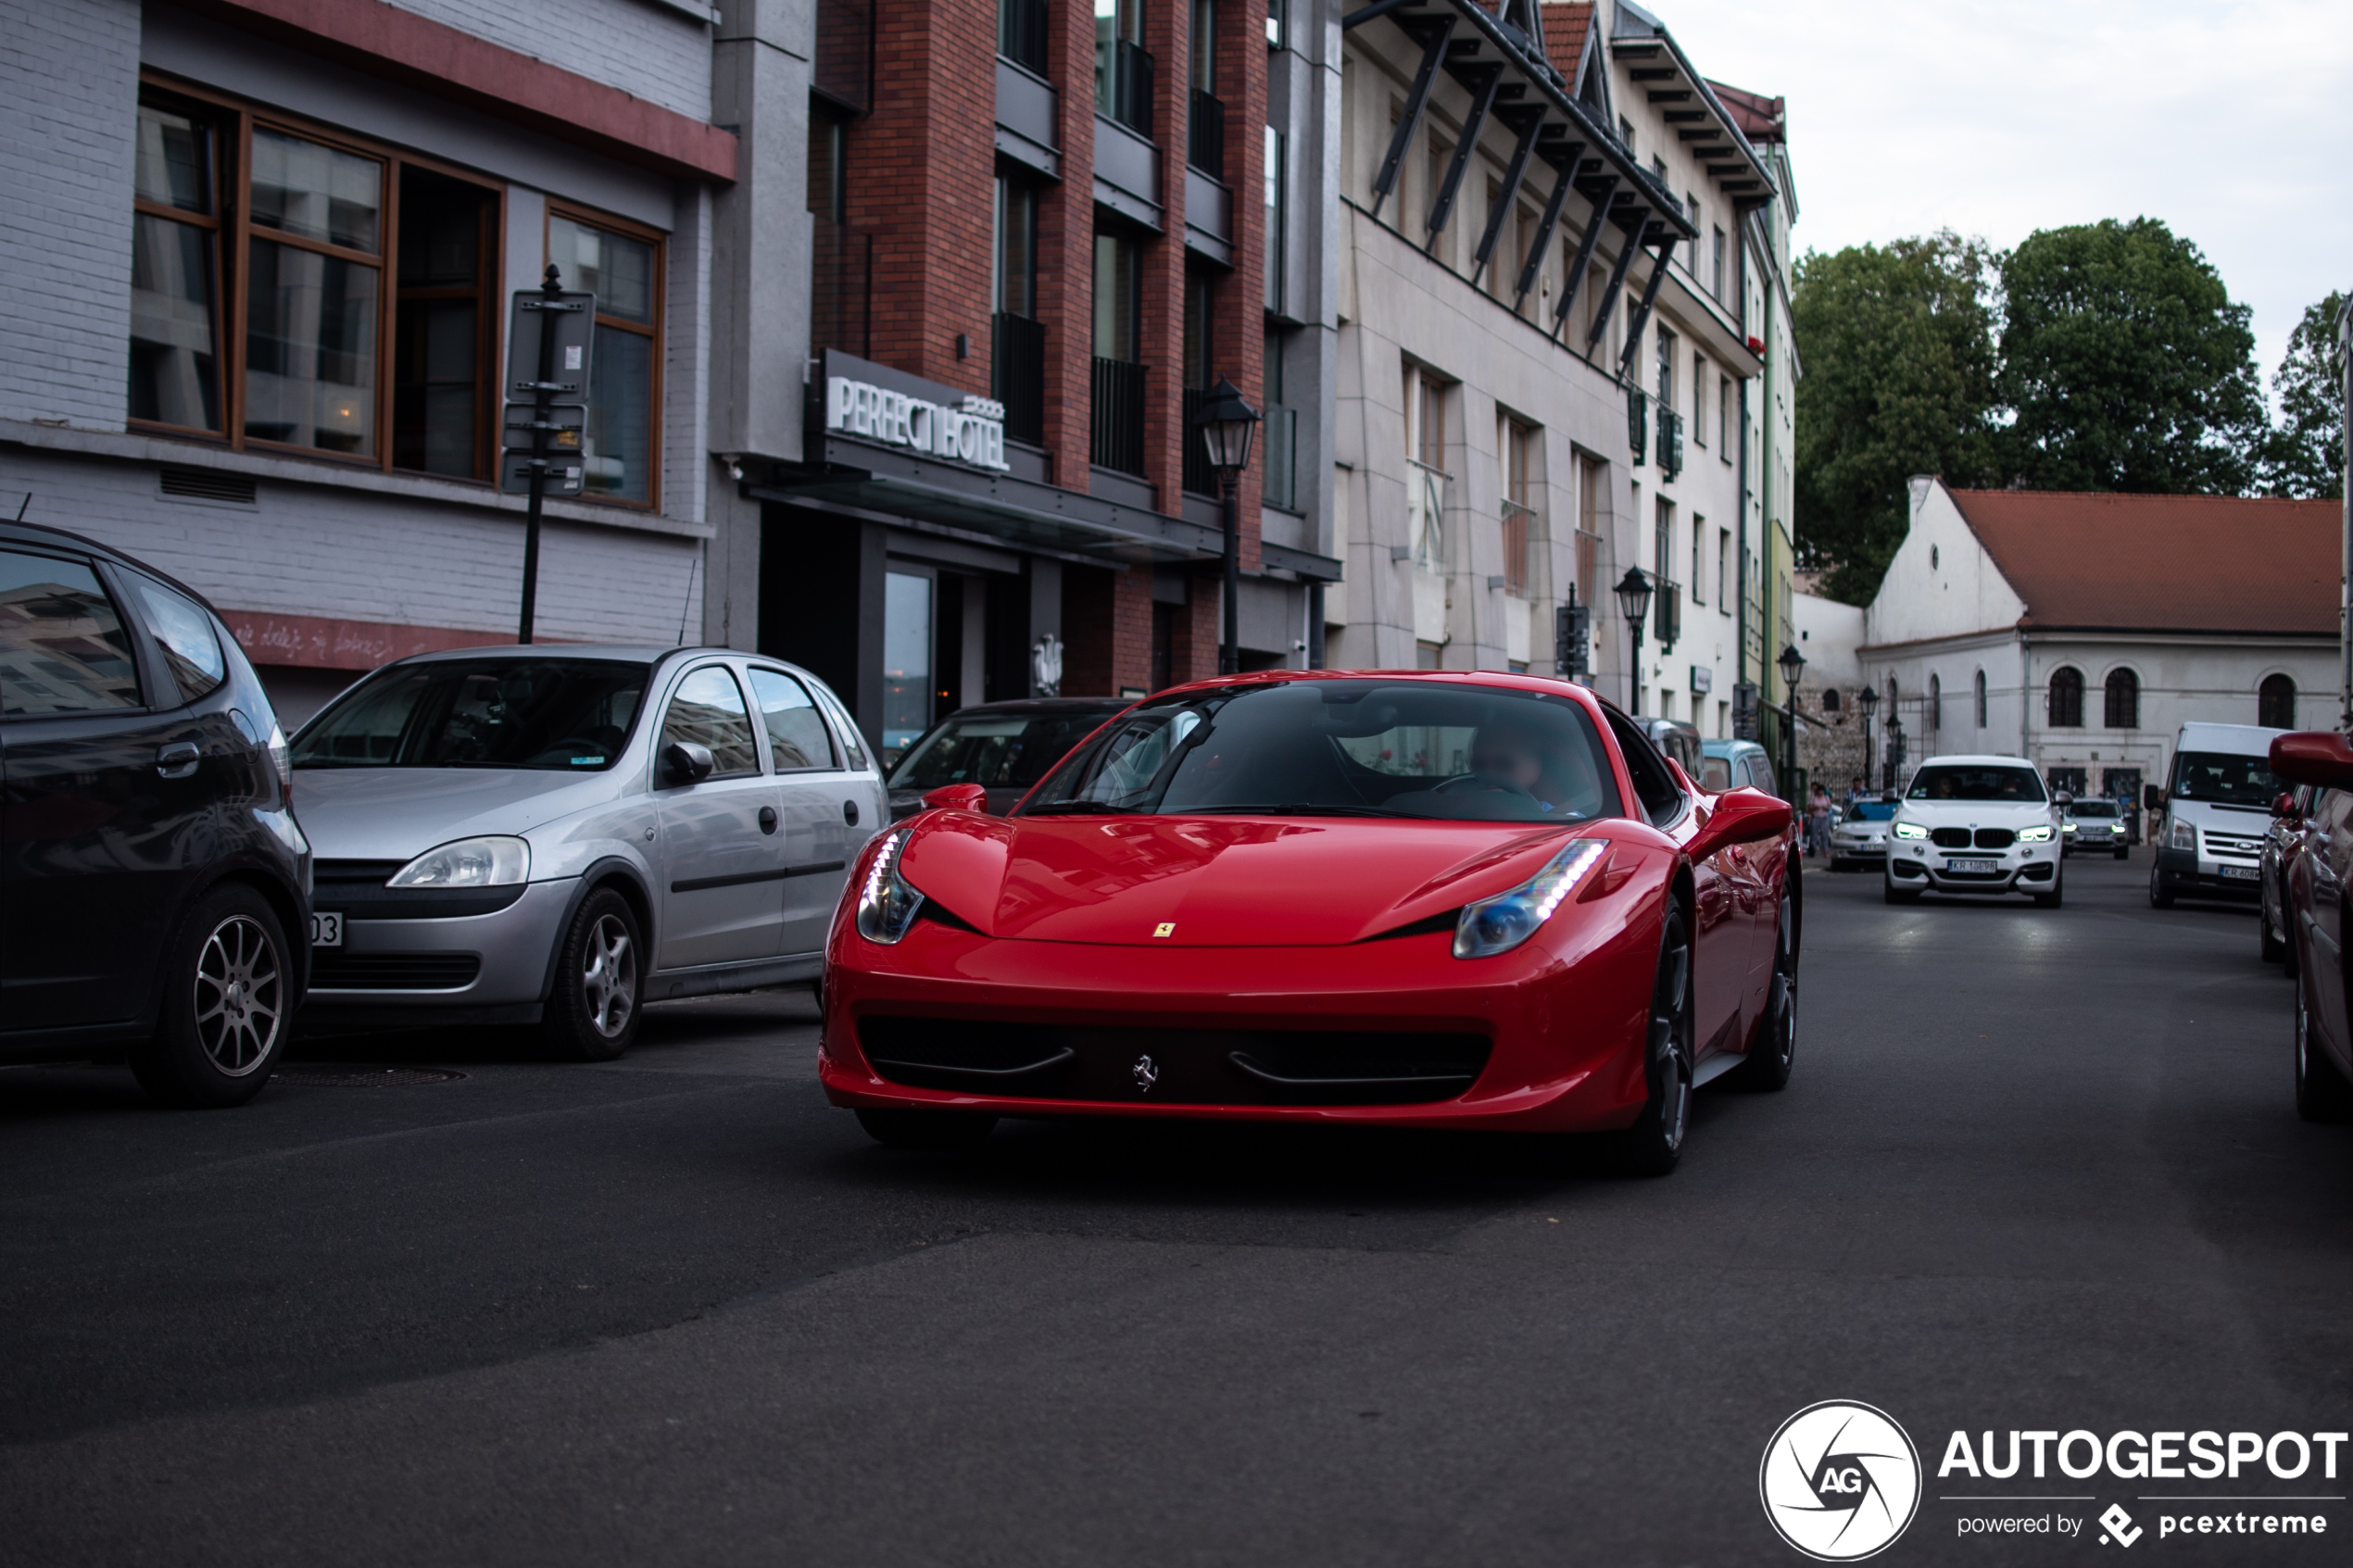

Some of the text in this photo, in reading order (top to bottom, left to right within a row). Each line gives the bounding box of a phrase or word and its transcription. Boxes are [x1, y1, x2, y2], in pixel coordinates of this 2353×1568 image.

[828, 376, 1010, 471] PERFECT HOTEL
[2224, 868, 2238, 878] KR
